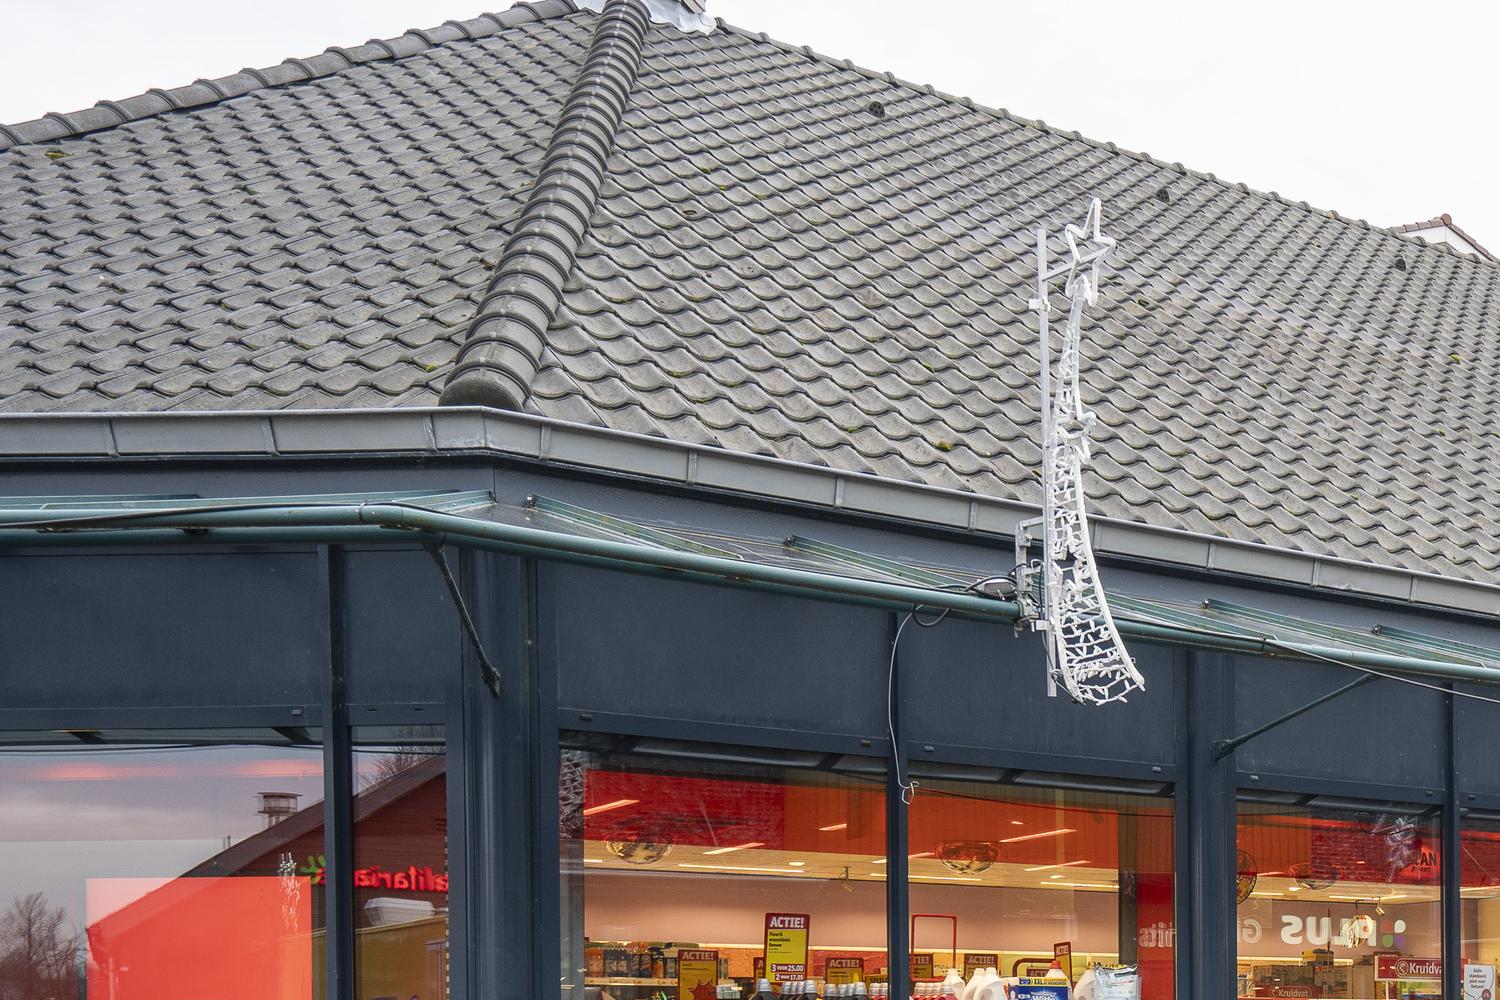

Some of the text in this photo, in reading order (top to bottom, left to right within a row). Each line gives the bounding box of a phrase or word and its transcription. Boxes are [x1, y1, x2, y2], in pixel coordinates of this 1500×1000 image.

[770, 916, 804, 928] ACTIE!
[682, 952, 714, 960] ACTIE!
[829, 958, 860, 968] ACTIE!
[1278, 988, 1308, 997] Kruidvat
